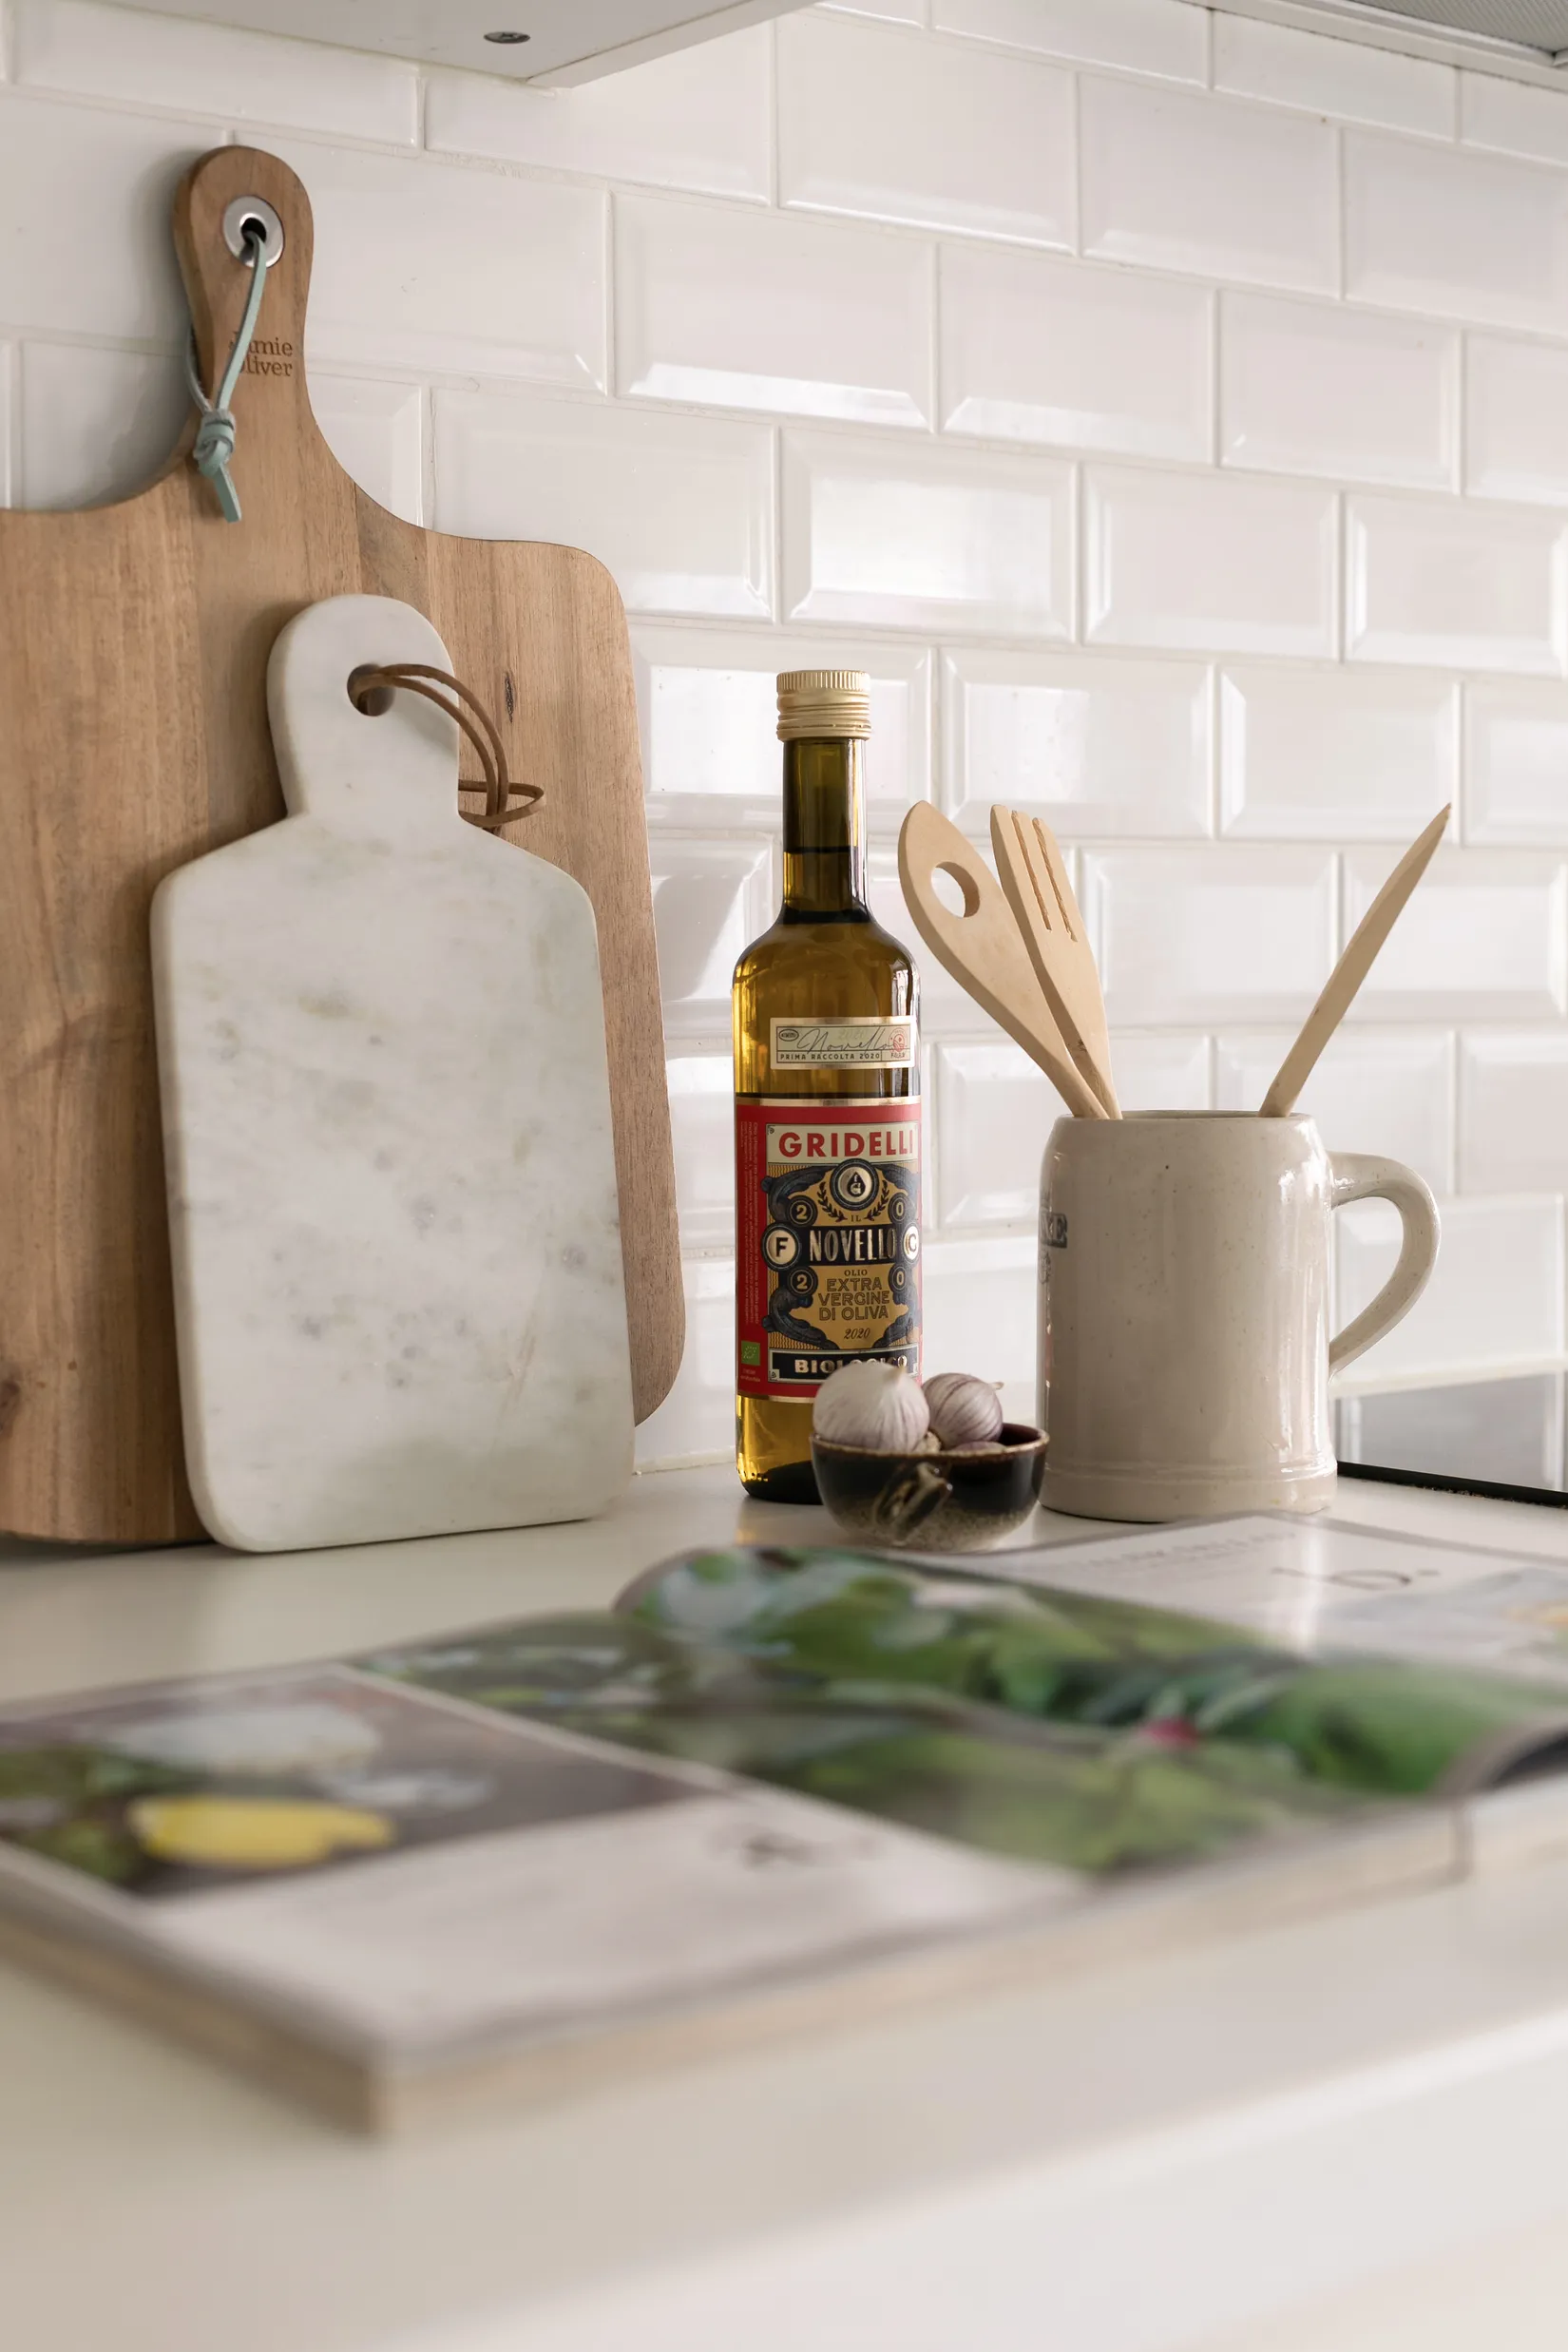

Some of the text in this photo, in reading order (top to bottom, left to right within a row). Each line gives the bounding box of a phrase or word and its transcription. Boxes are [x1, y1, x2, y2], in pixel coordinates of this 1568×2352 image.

[239, 354, 293, 377] liver
[811, 1052, 854, 1061] RACCOLTA
[778, 1129, 913, 1158] GRIDELLI
[796, 1204, 808, 1220] 2
[775, 1237, 789, 1257] F
[810, 1228, 897, 1262] NOVELLO
[844, 1269, 869, 1277] OLIO
[796, 1273, 808, 1290] 2
[826, 1277, 883, 1292] EXTRA
[817, 1291, 890, 1307] VERGINE
[818, 1306, 889, 1321] DI OLIVA
[843, 1327, 871, 1340] 2020
